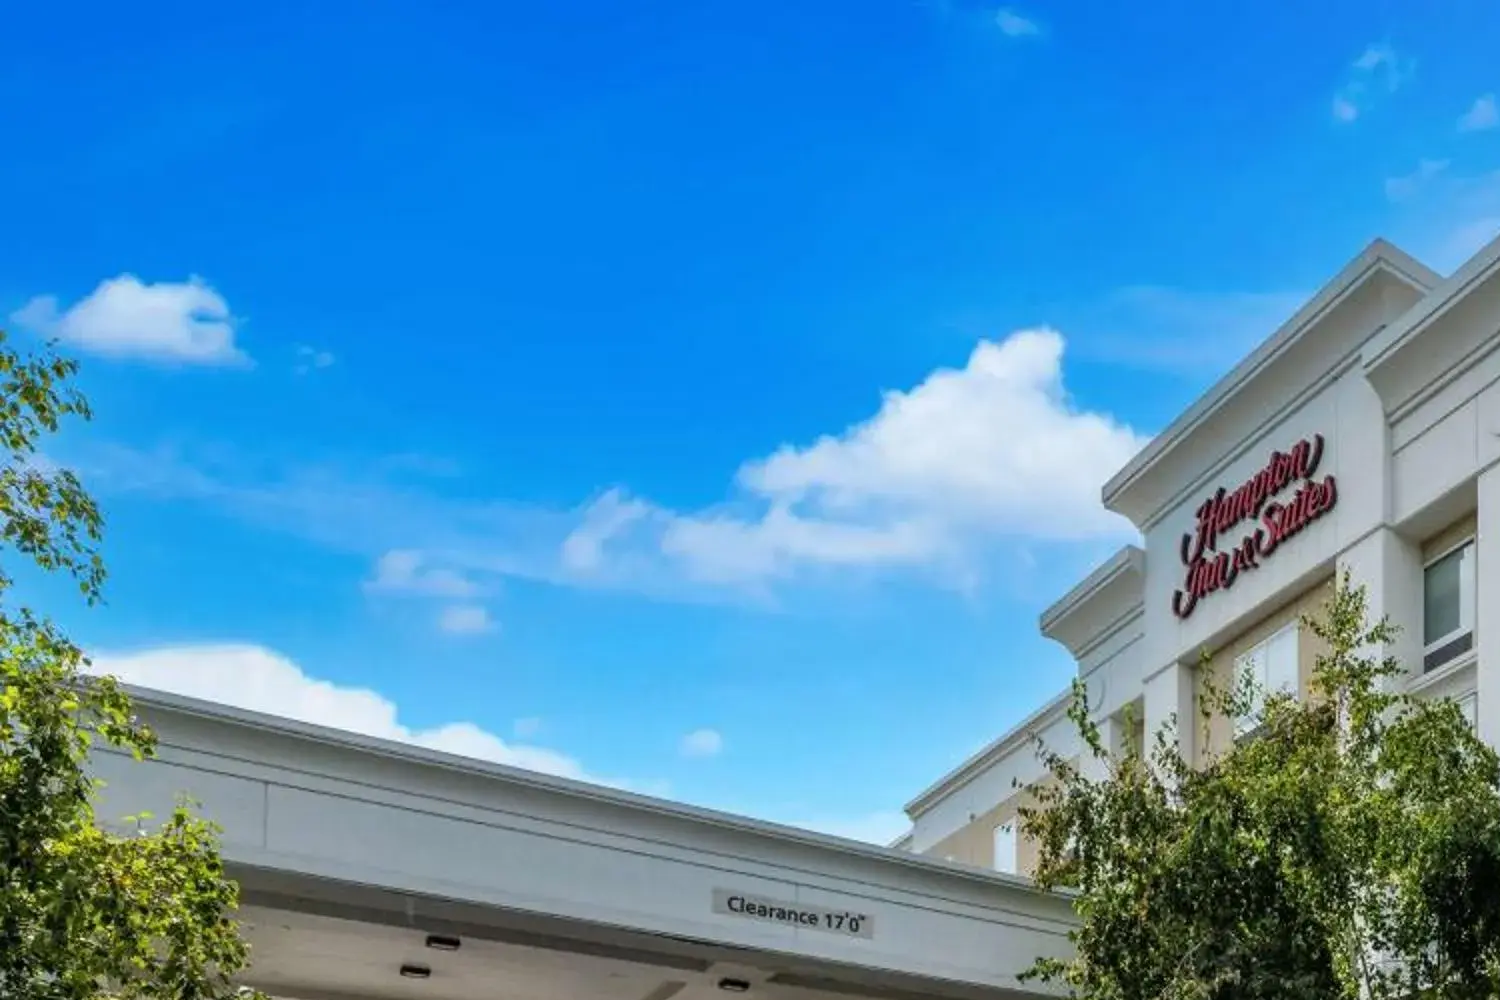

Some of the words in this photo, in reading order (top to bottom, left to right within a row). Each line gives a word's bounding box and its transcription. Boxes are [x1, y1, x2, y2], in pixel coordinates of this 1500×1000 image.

[1173, 551, 1239, 619] Inn
[1254, 474, 1338, 557] Suites
[1181, 434, 1324, 565] Hampton
[727, 895, 818, 926] Clearance
